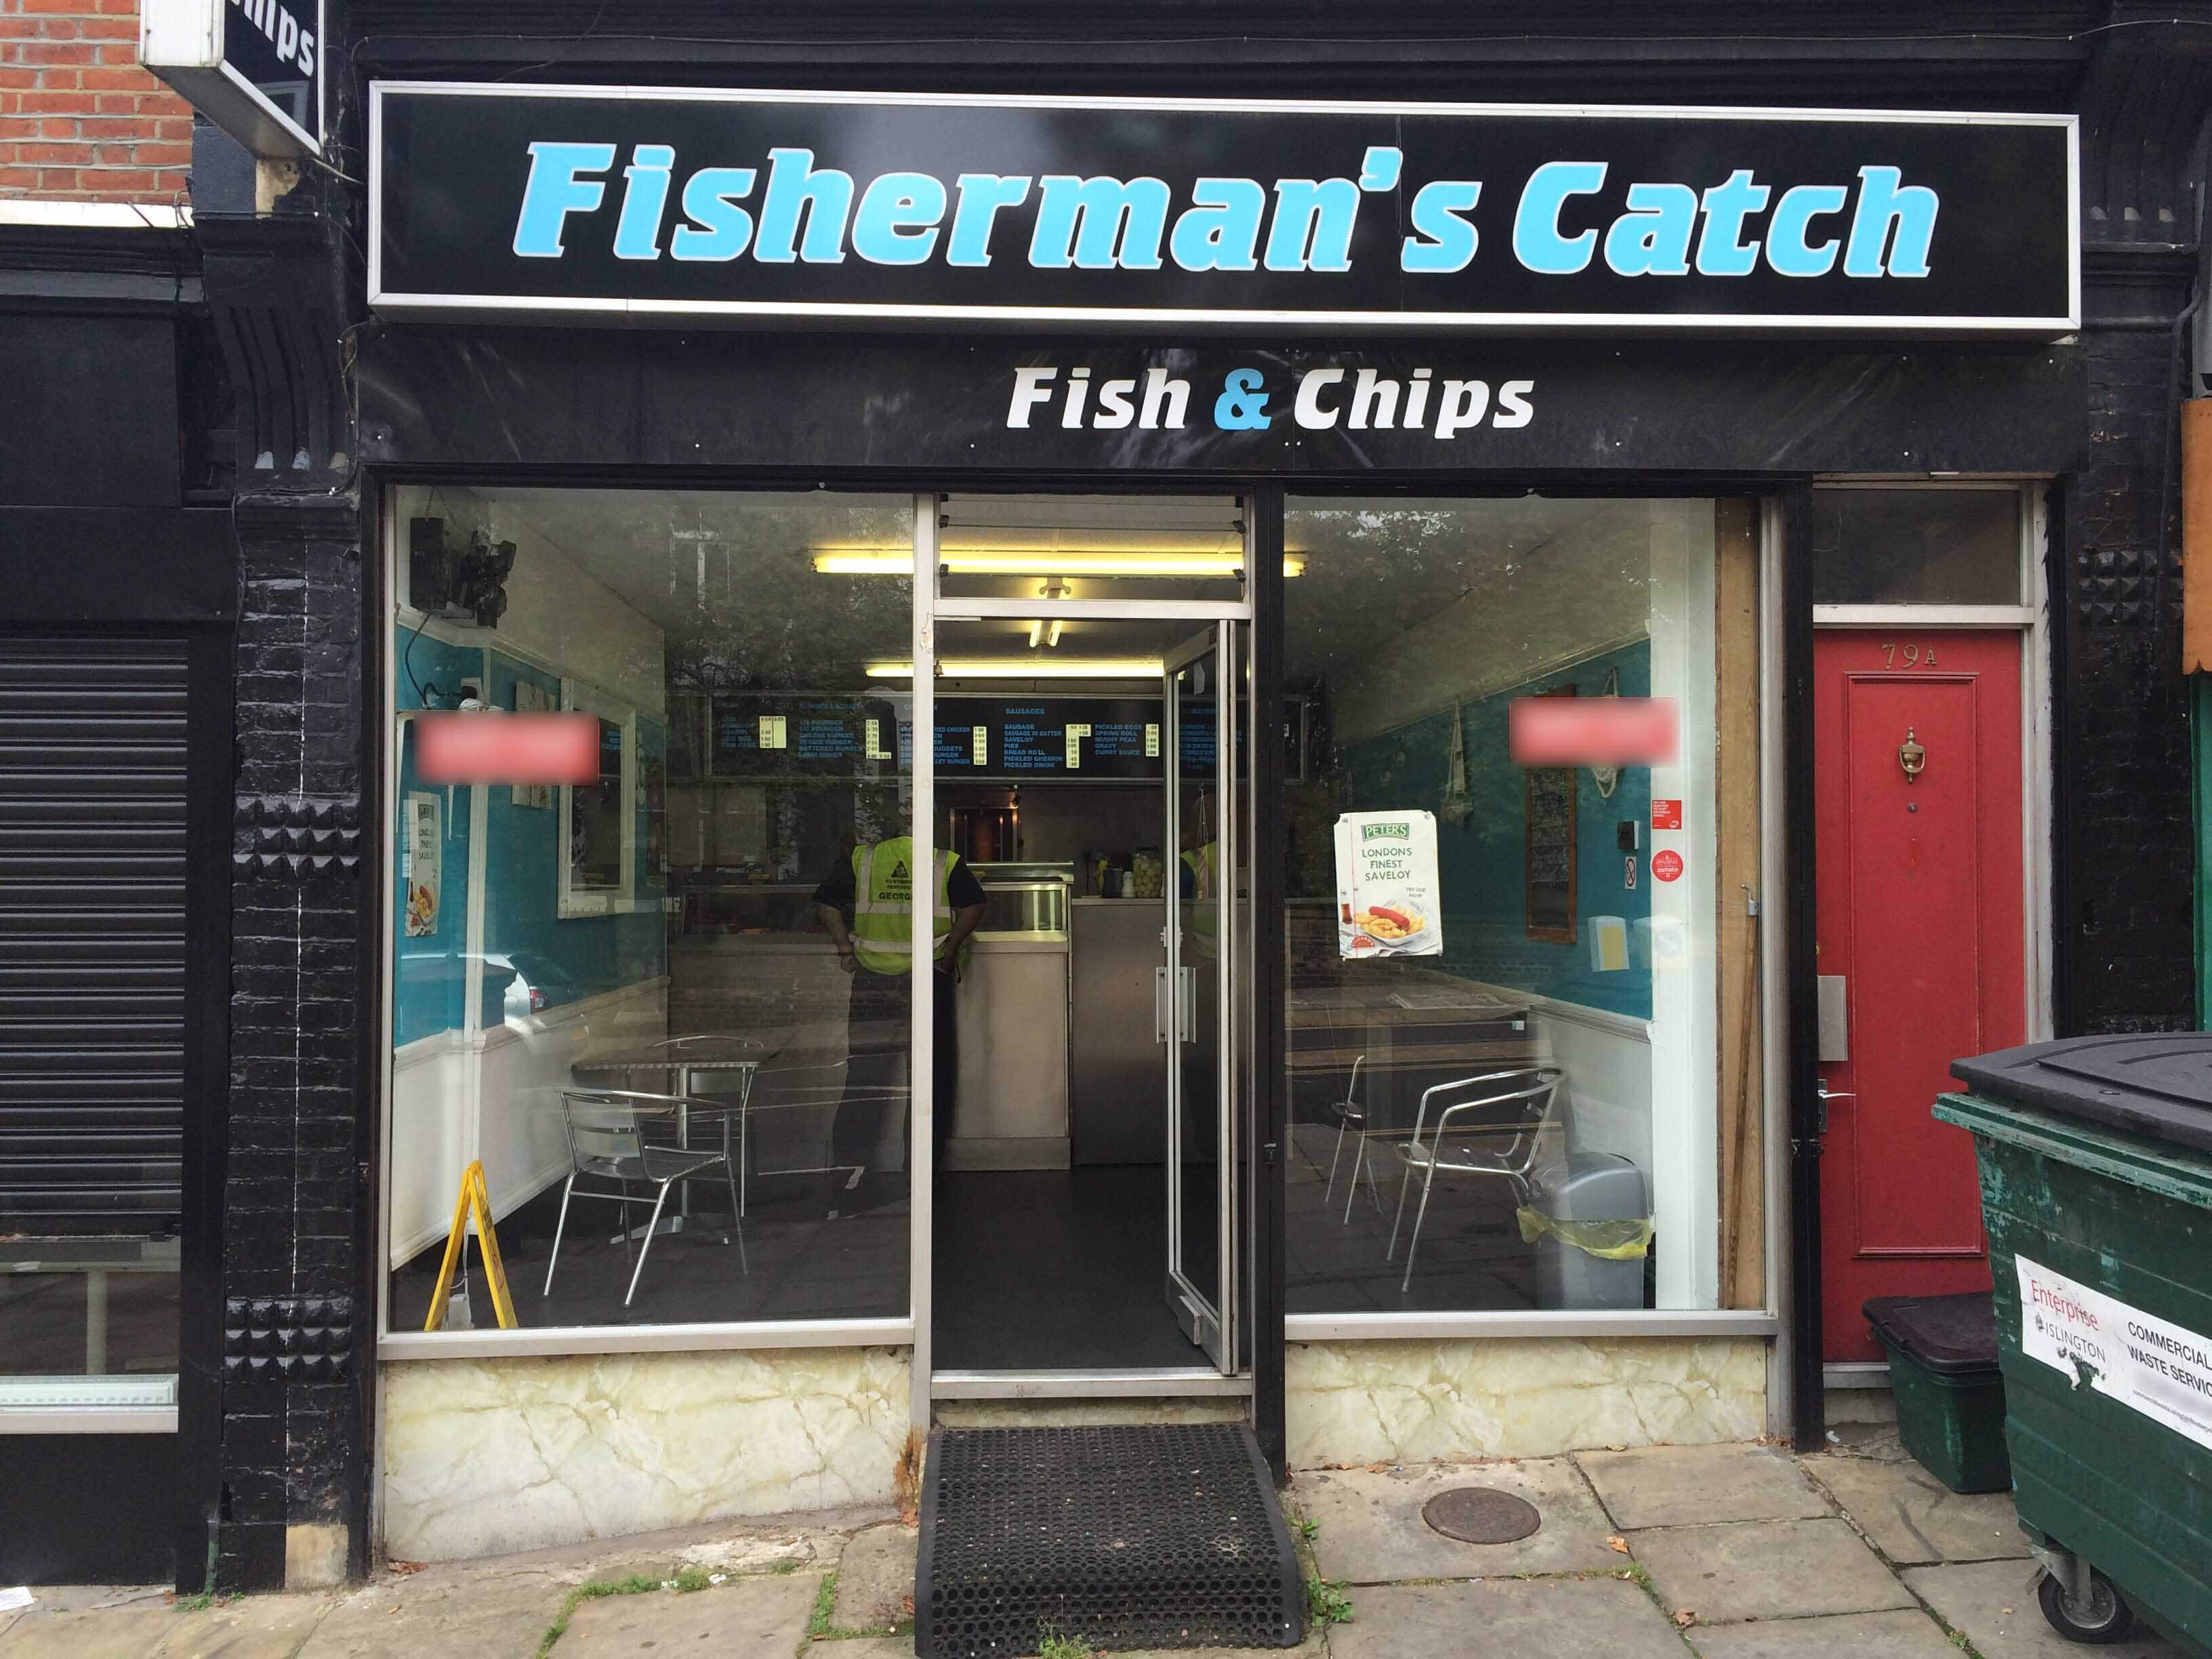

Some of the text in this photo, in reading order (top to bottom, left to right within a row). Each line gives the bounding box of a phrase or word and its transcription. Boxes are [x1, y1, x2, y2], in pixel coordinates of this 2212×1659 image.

[512, 142, 1939, 277] Fisherman's Catch
[1006, 367, 1536, 440] Fish & Chips
[1881, 642, 1938, 670] 79A
[1365, 869, 1411, 881] SAVELOY
[1370, 859, 1403, 869] FINEST
[2030, 1279, 2099, 1331] Enterprise
[2045, 1322, 2106, 1363] ISLINGTON
[2127, 1344, 2169, 1376] WASTE
[2128, 1322, 2212, 1370] COMMERCIAL
